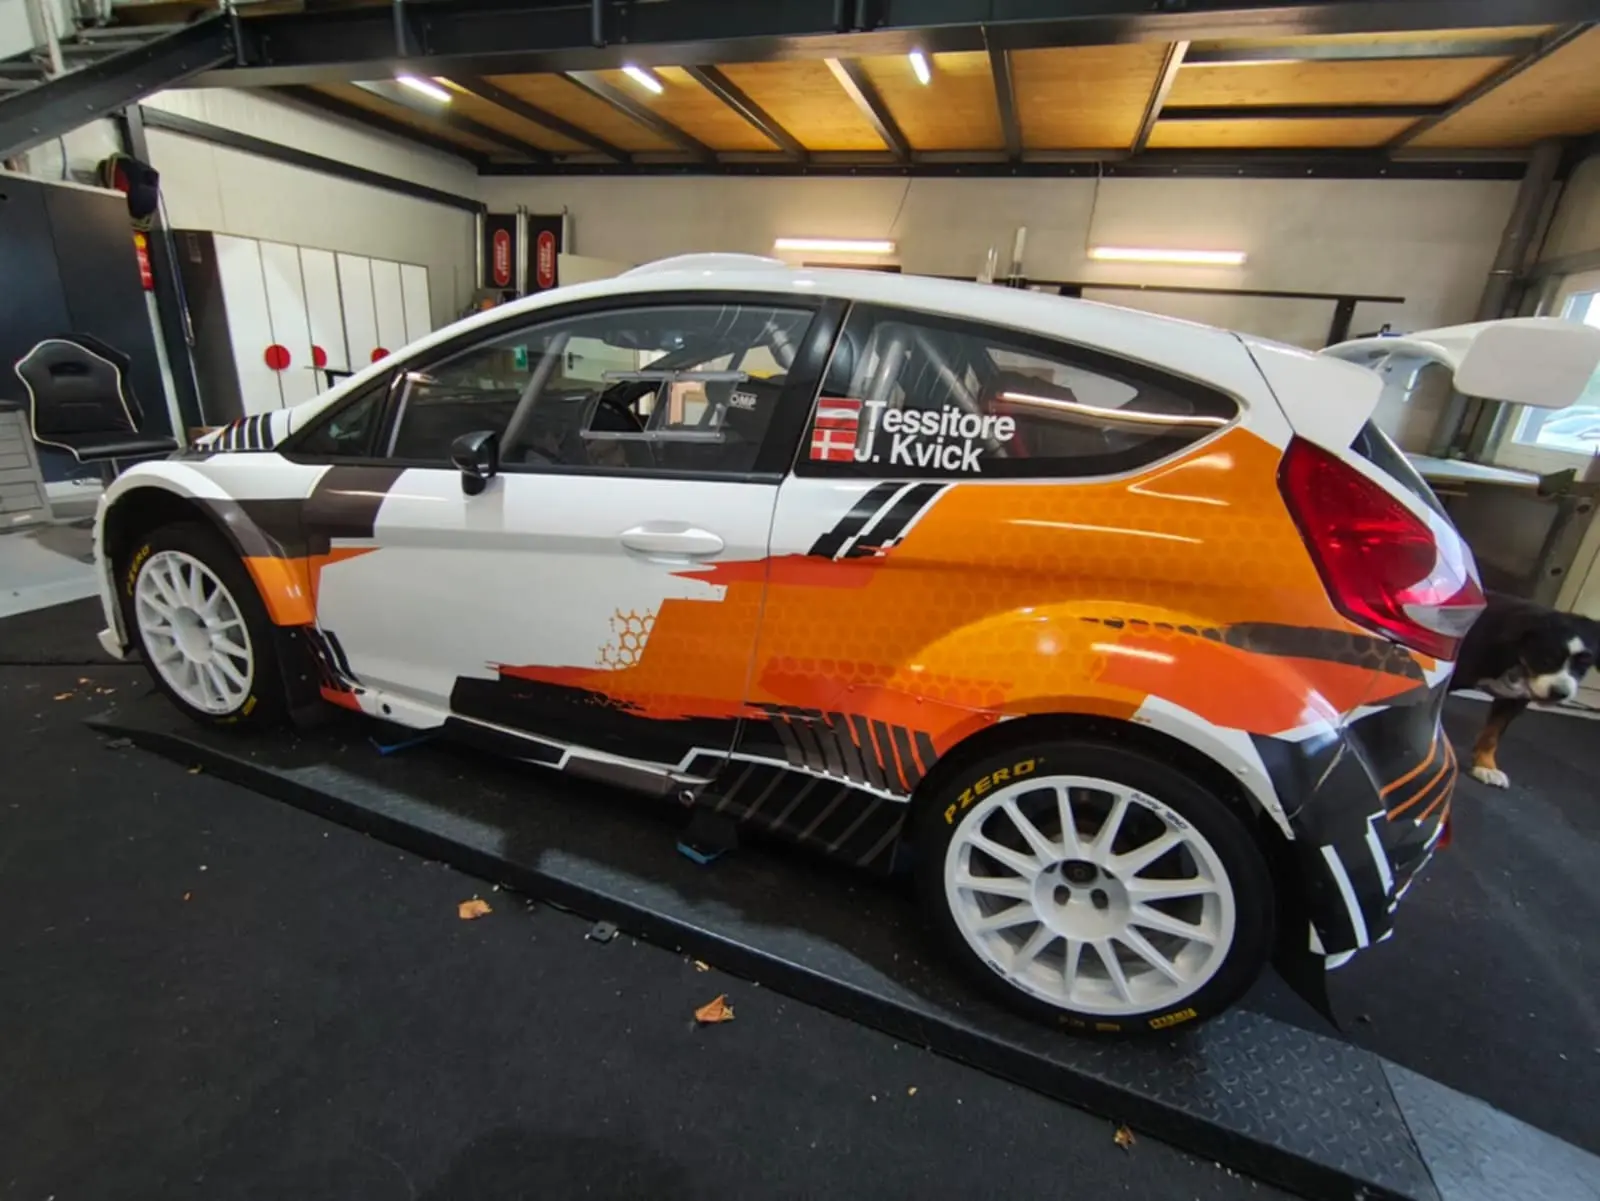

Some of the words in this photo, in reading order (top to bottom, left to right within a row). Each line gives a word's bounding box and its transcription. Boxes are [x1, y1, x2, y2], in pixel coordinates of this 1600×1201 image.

[730, 393, 757, 405] OMP
[864, 400, 1016, 442] Tessitore
[855, 431, 880, 463] J.
[890, 434, 984, 473] Kvick
